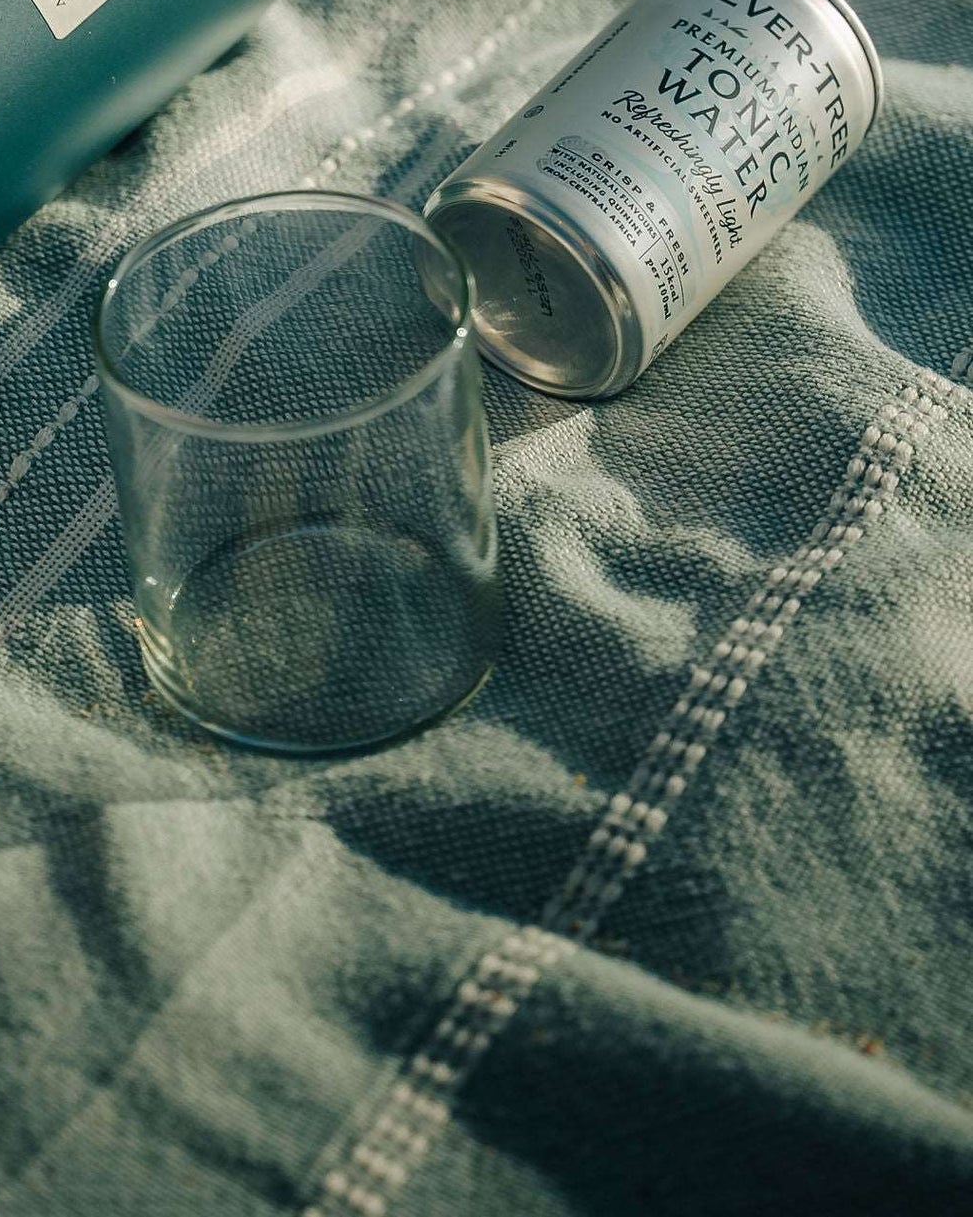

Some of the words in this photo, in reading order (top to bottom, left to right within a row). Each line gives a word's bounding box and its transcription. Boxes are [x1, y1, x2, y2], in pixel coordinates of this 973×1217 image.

[612, 90, 723, 200] Refreshingly
[716, 198, 743, 248] Light
[658, 68, 767, 219] WATER
[671, 18, 776, 101] PREMIUM
[777, 105, 809, 193] INDIAN
[683, 47, 791, 184] TONIC
[543, 166, 569, 182] FROM
[569, 180, 608, 214] CENTRAL
[609, 214, 636, 247] AFRICA
[551, 147, 577, 162] WITH
[578, 161, 618, 195] NATURAL
[619, 193, 657, 239] FLAVOURS
[554, 160, 605, 197] INCLUDING
[608, 197, 643, 237] QUININE
[591, 152, 643, 195] CRISP
[645, 201, 655, 214] &
[659, 217, 689, 276] FRESH
[600, 110, 622, 124] NO
[624, 124, 687, 183] ARTIFICIAL
[688, 185, 723, 264] SWEETENERS
[645, 258, 660, 279] per
[658, 280, 672, 320] 100ml
